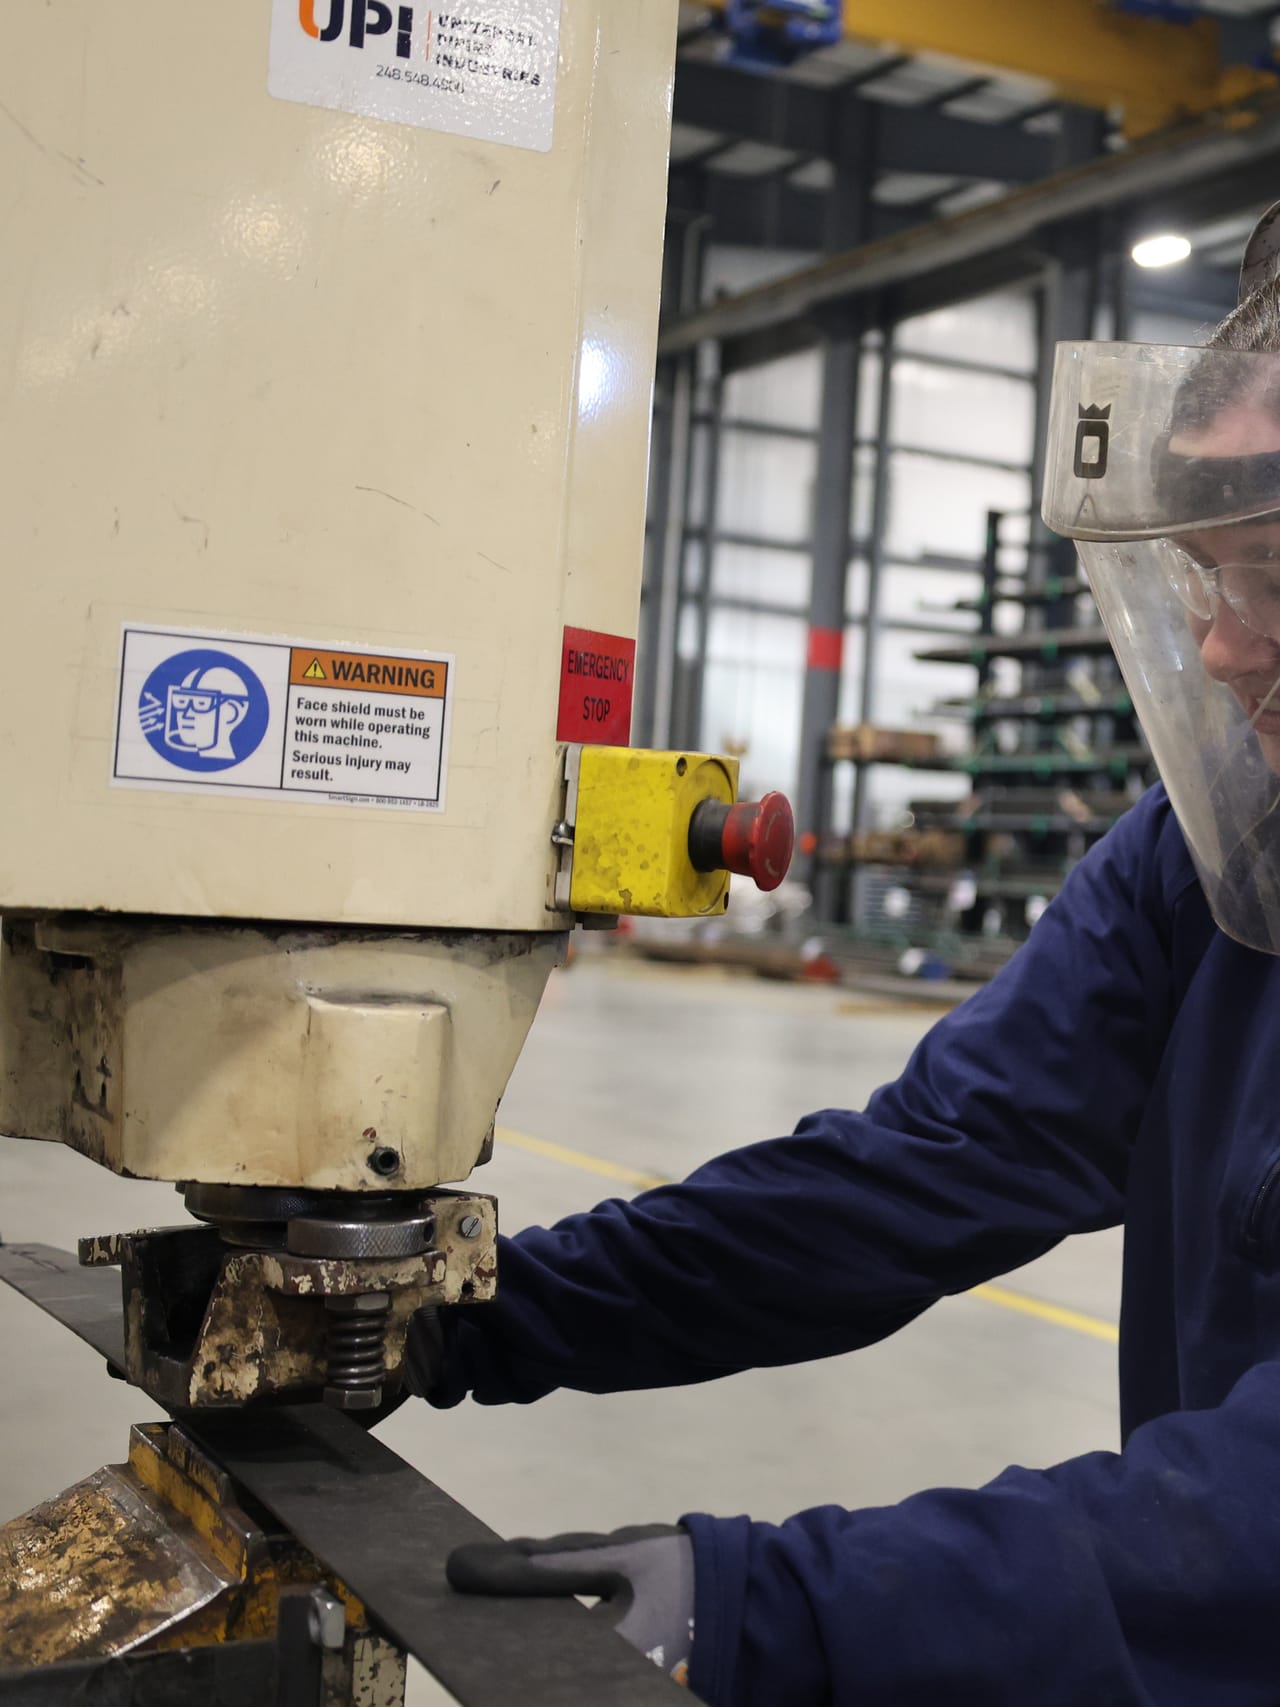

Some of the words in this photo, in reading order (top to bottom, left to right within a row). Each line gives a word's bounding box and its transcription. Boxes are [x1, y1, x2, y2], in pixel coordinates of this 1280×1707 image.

[298, 0, 413, 59] UPI
[332, 659, 436, 689] WARNING
[568, 649, 629, 682] EMERGENCY
[297, 696, 328, 712] Face
[331, 700, 371, 716] shield
[374, 706, 407, 719] must
[410, 707, 425, 721] be
[583, 695, 611, 723] STOP
[294, 729, 319, 743] this
[322, 733, 382, 749] machine.
[295, 715, 327, 728] worn
[330, 717, 365, 732] while
[368, 722, 431, 740] operating
[292, 749, 342, 766] Serious
[345, 754, 382, 772] injury
[385, 760, 411, 774] may
[291, 768, 334, 782] result.
